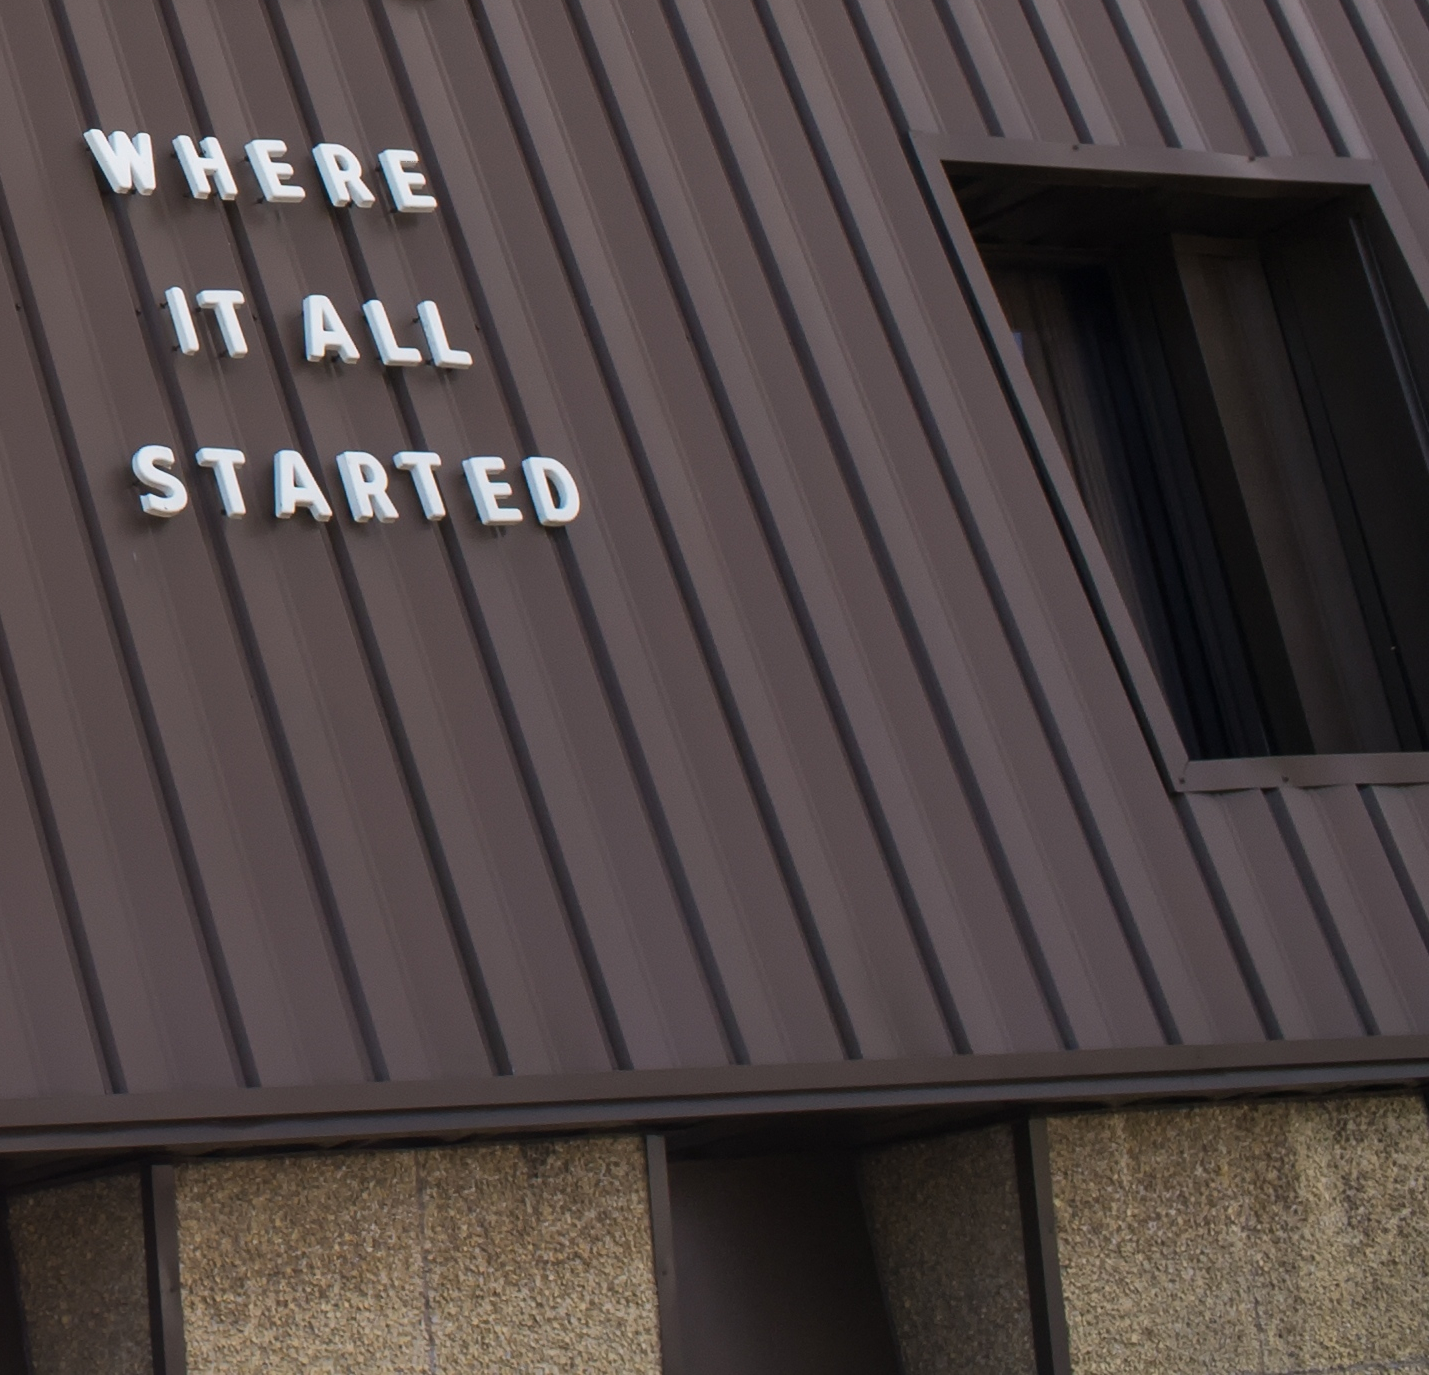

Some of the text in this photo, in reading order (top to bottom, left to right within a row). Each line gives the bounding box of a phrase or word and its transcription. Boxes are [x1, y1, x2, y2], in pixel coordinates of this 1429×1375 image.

[83, 128, 438, 212] WHERE
[164, 286, 473, 368] IT ALL
[132, 444, 581, 525] STARTED
